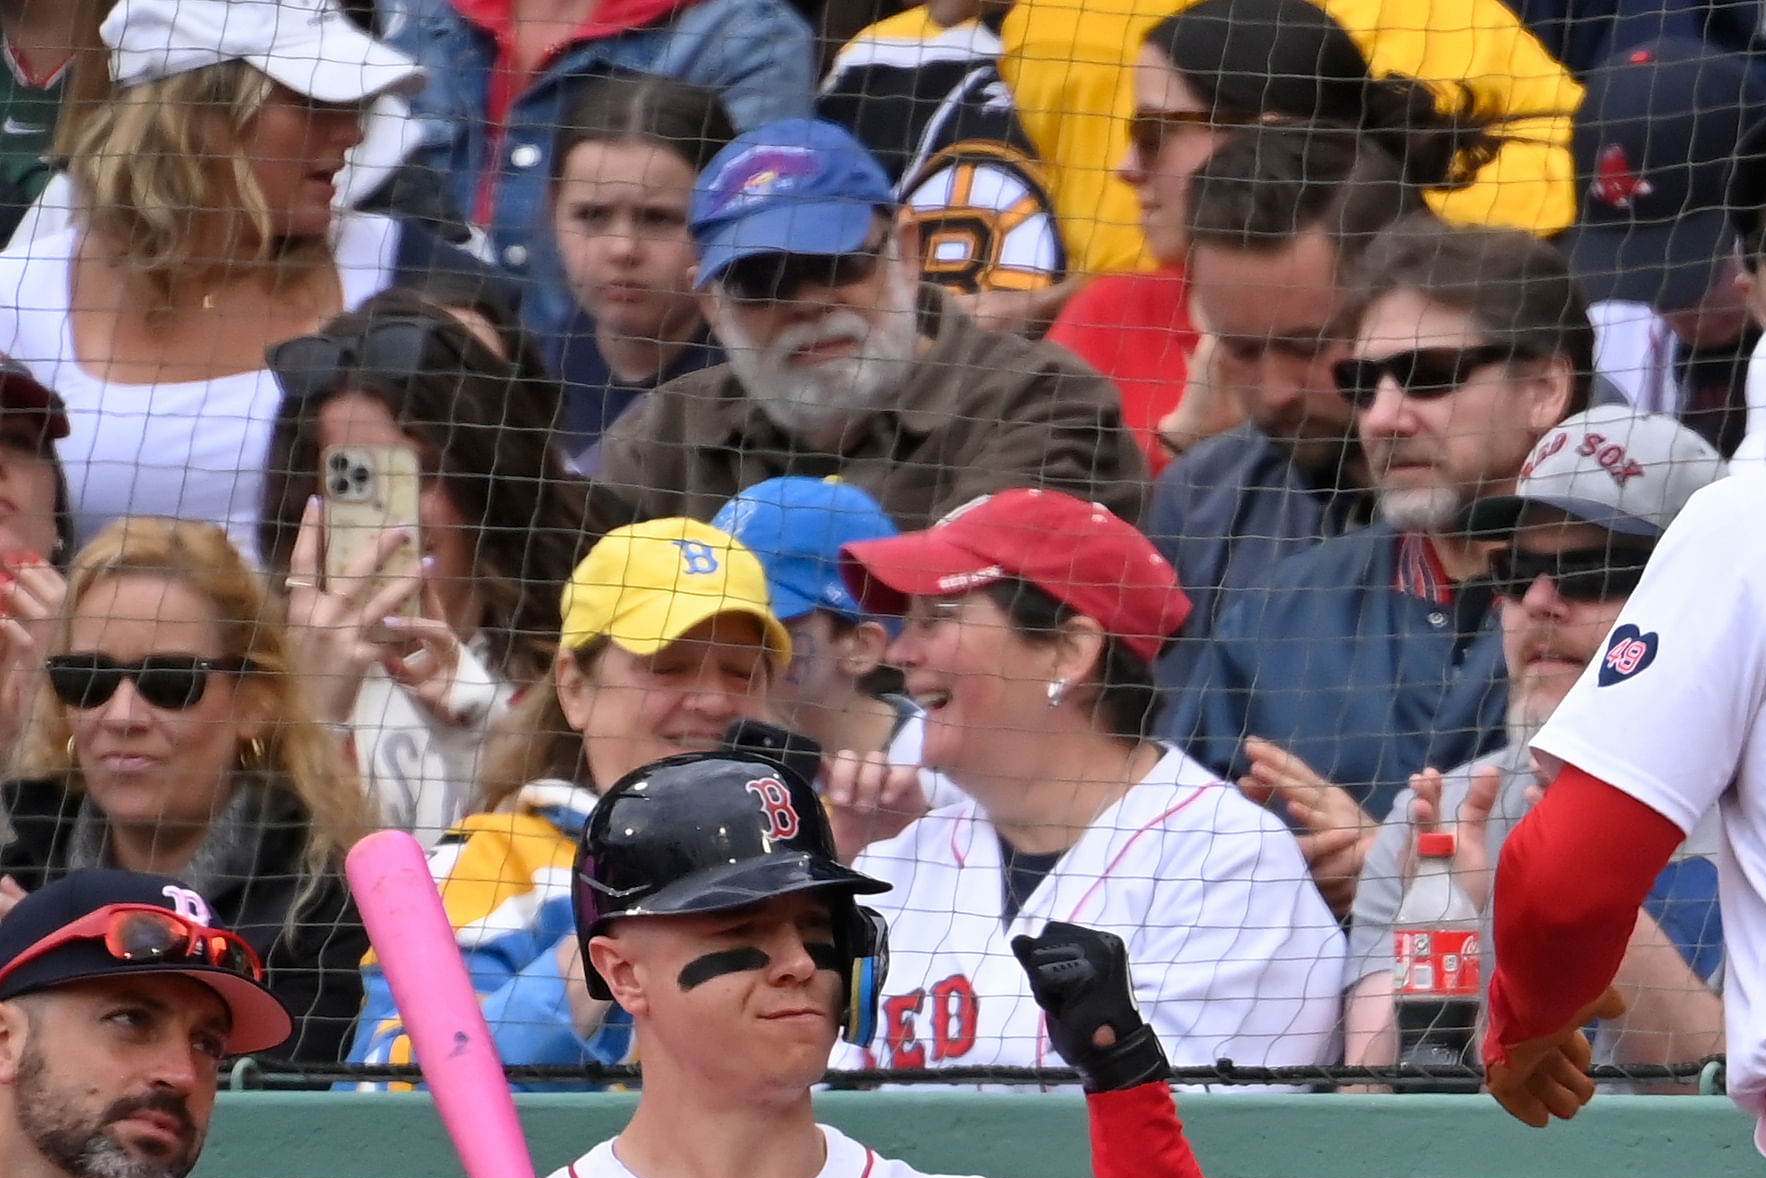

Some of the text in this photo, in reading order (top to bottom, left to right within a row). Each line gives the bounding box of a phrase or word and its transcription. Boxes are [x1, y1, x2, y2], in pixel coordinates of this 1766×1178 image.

[1576, 432, 1646, 488] SOX
[671, 539, 719, 575] B
[1606, 636, 1648, 675] 49
[744, 777, 801, 843] B
[864, 973, 981, 1070] ED
